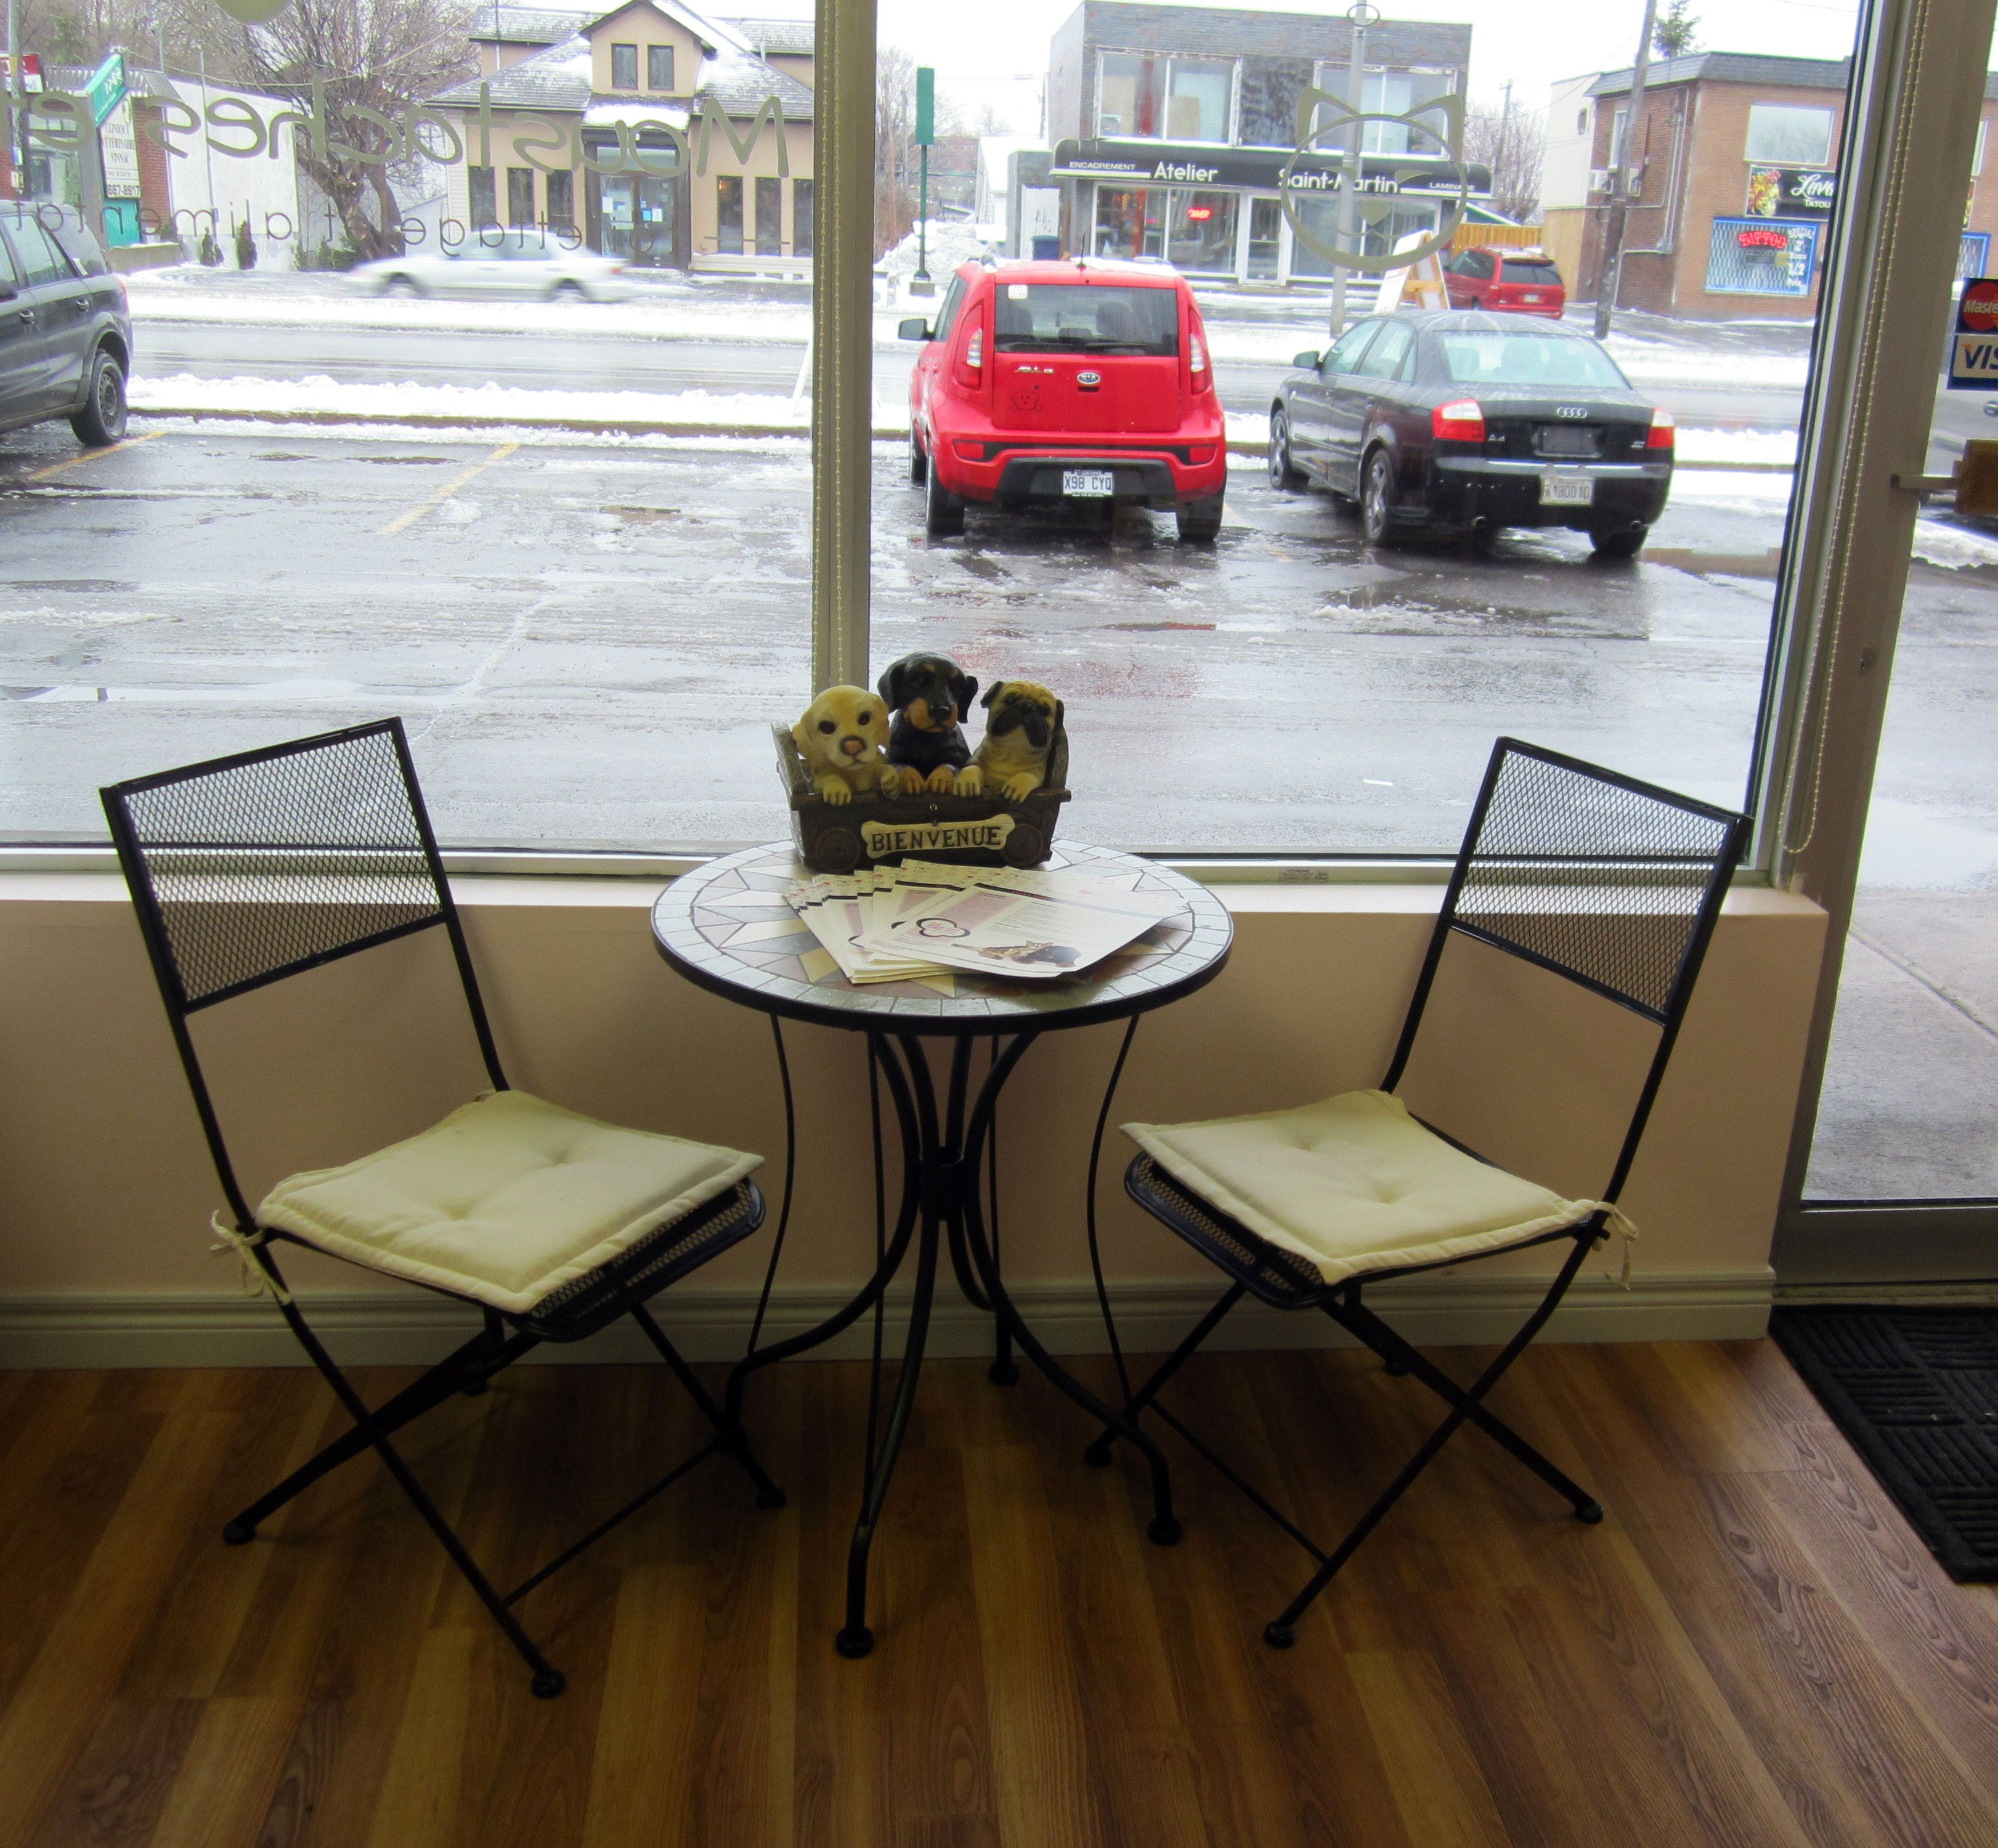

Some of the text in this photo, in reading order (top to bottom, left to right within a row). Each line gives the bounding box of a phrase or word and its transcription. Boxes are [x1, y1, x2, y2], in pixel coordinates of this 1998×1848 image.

[1070, 161, 1135, 170] ENCADREMENT
[1153, 161, 1219, 182] Atelier
[1430, 182, 1475, 192] LAMINAE
[1065, 476, 1084, 489] X98
[871, 826, 1001, 852] BIENVENUE
